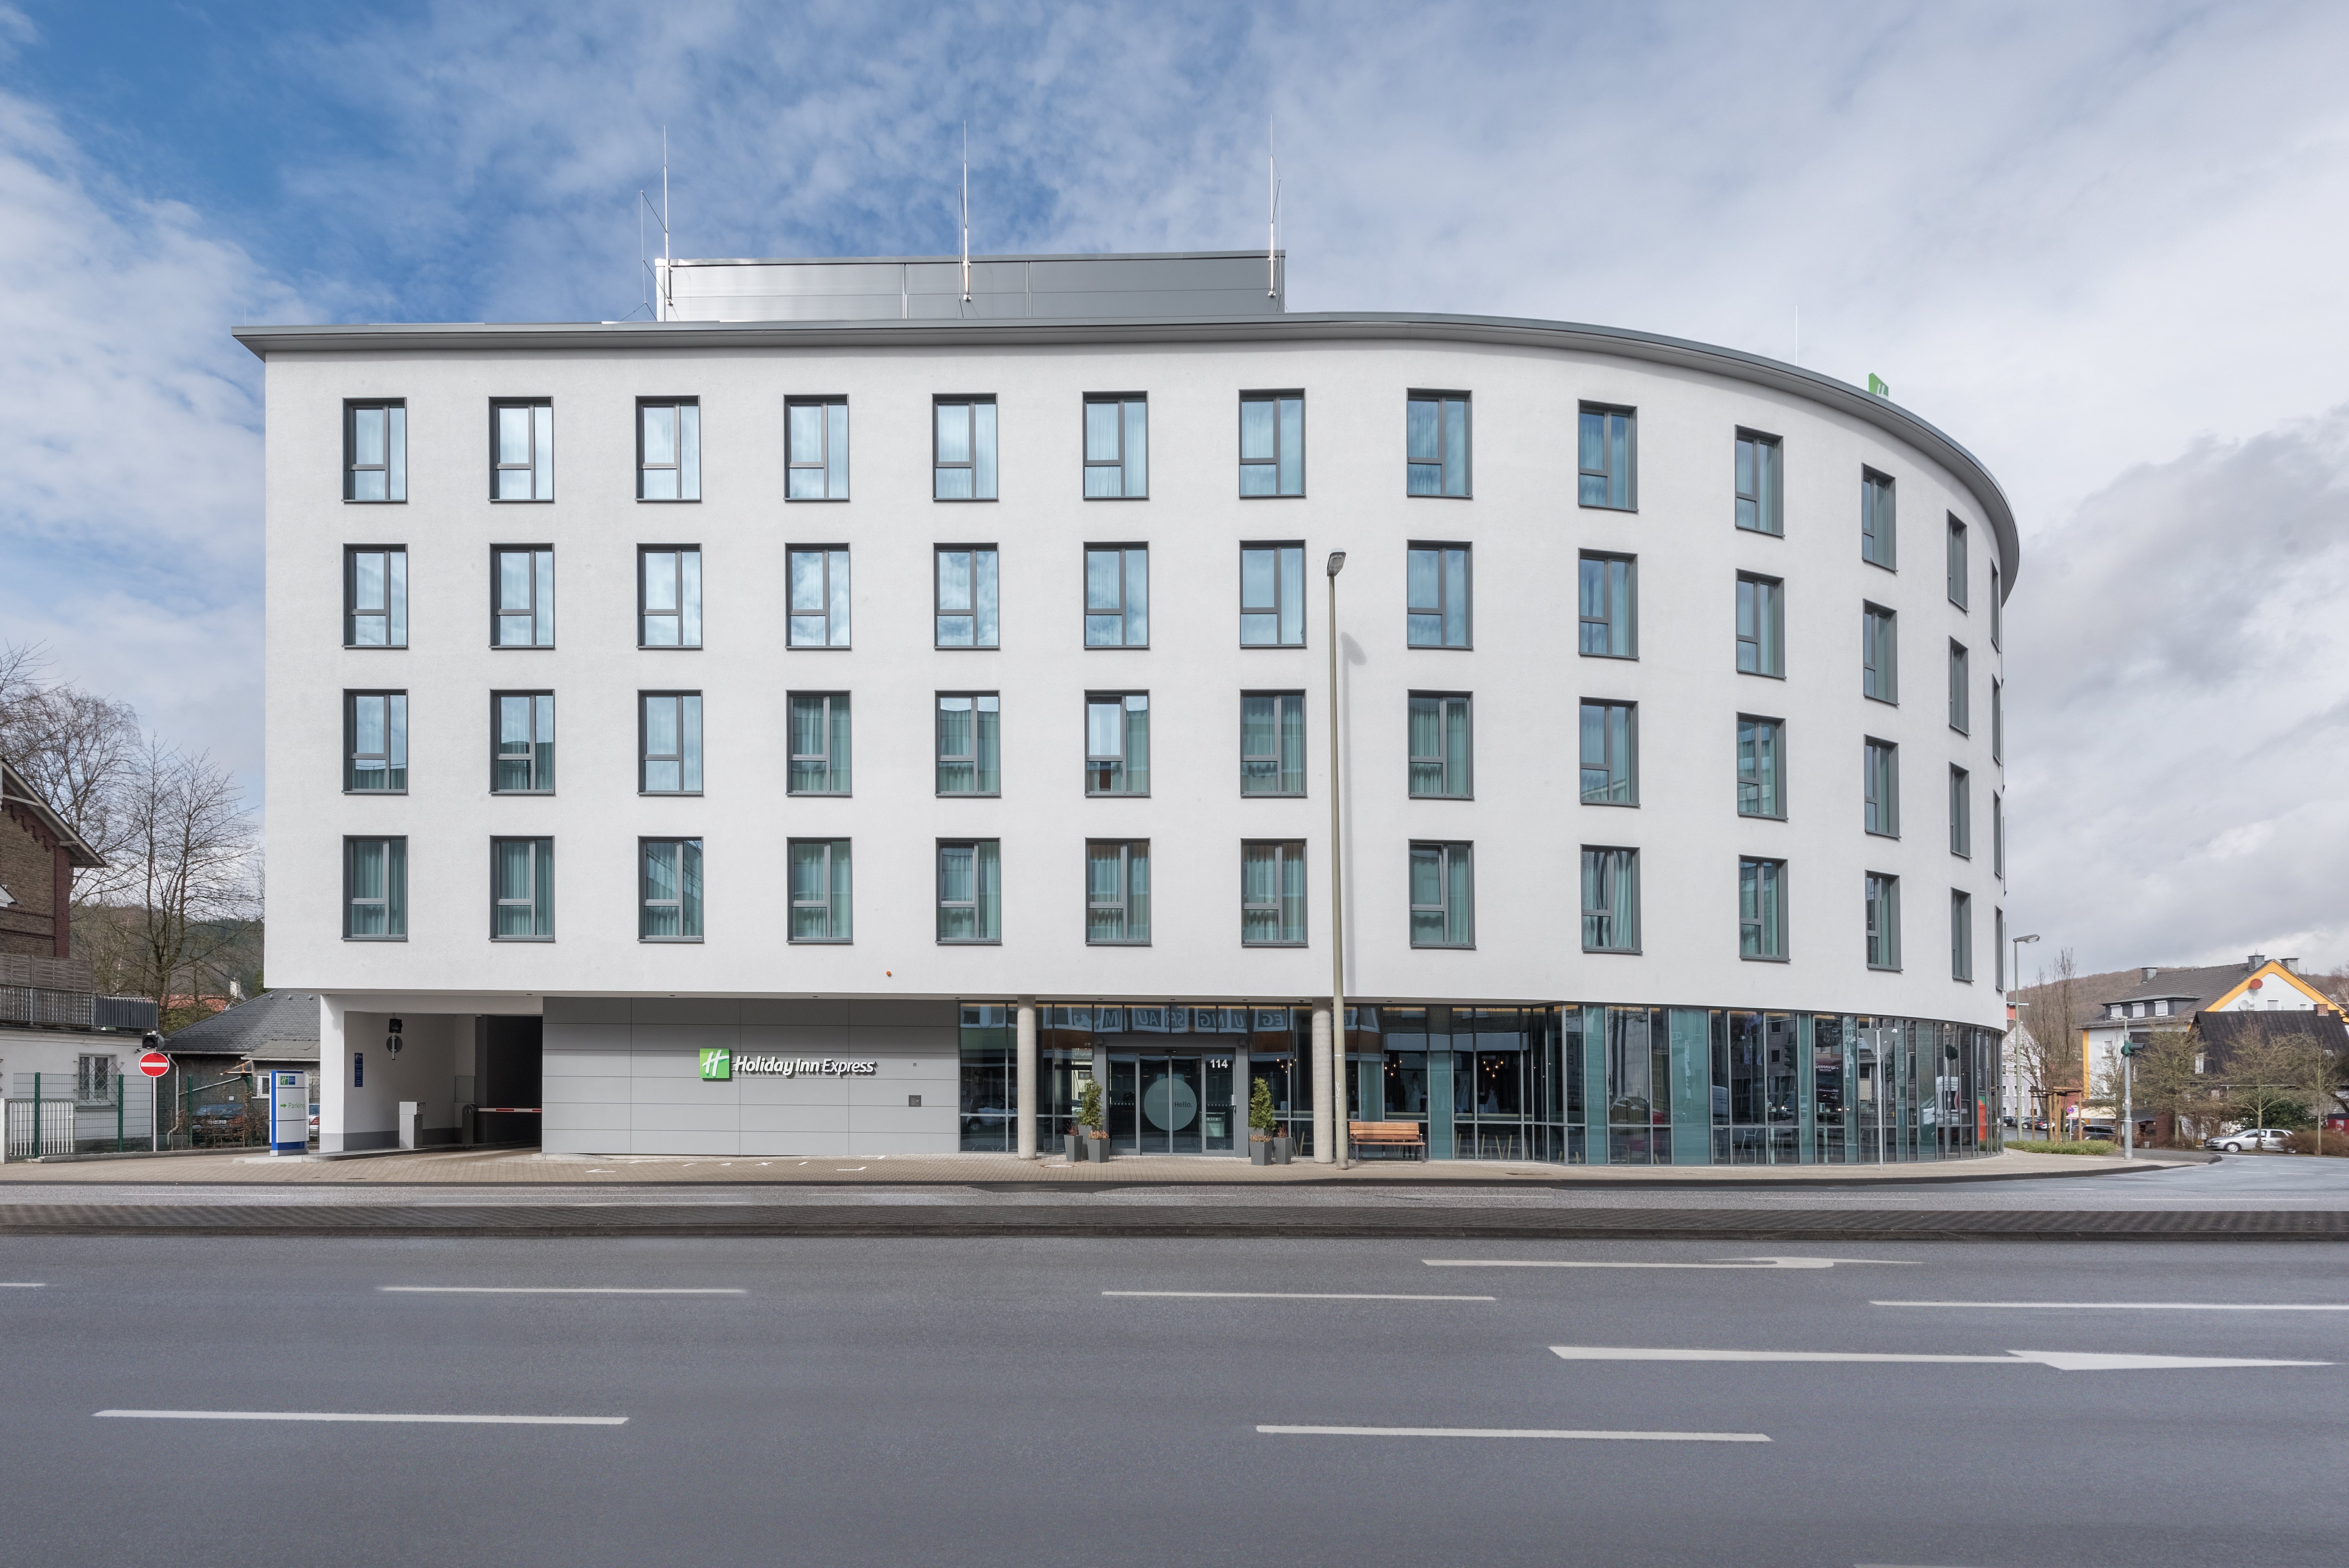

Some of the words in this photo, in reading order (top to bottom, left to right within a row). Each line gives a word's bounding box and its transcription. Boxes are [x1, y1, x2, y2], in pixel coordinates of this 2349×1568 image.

[734, 1056, 794, 1075] Holiday
[796, 1058, 820, 1072] Inn
[823, 1059, 874, 1075] Express
[1210, 1059, 1228, 1068] 114
